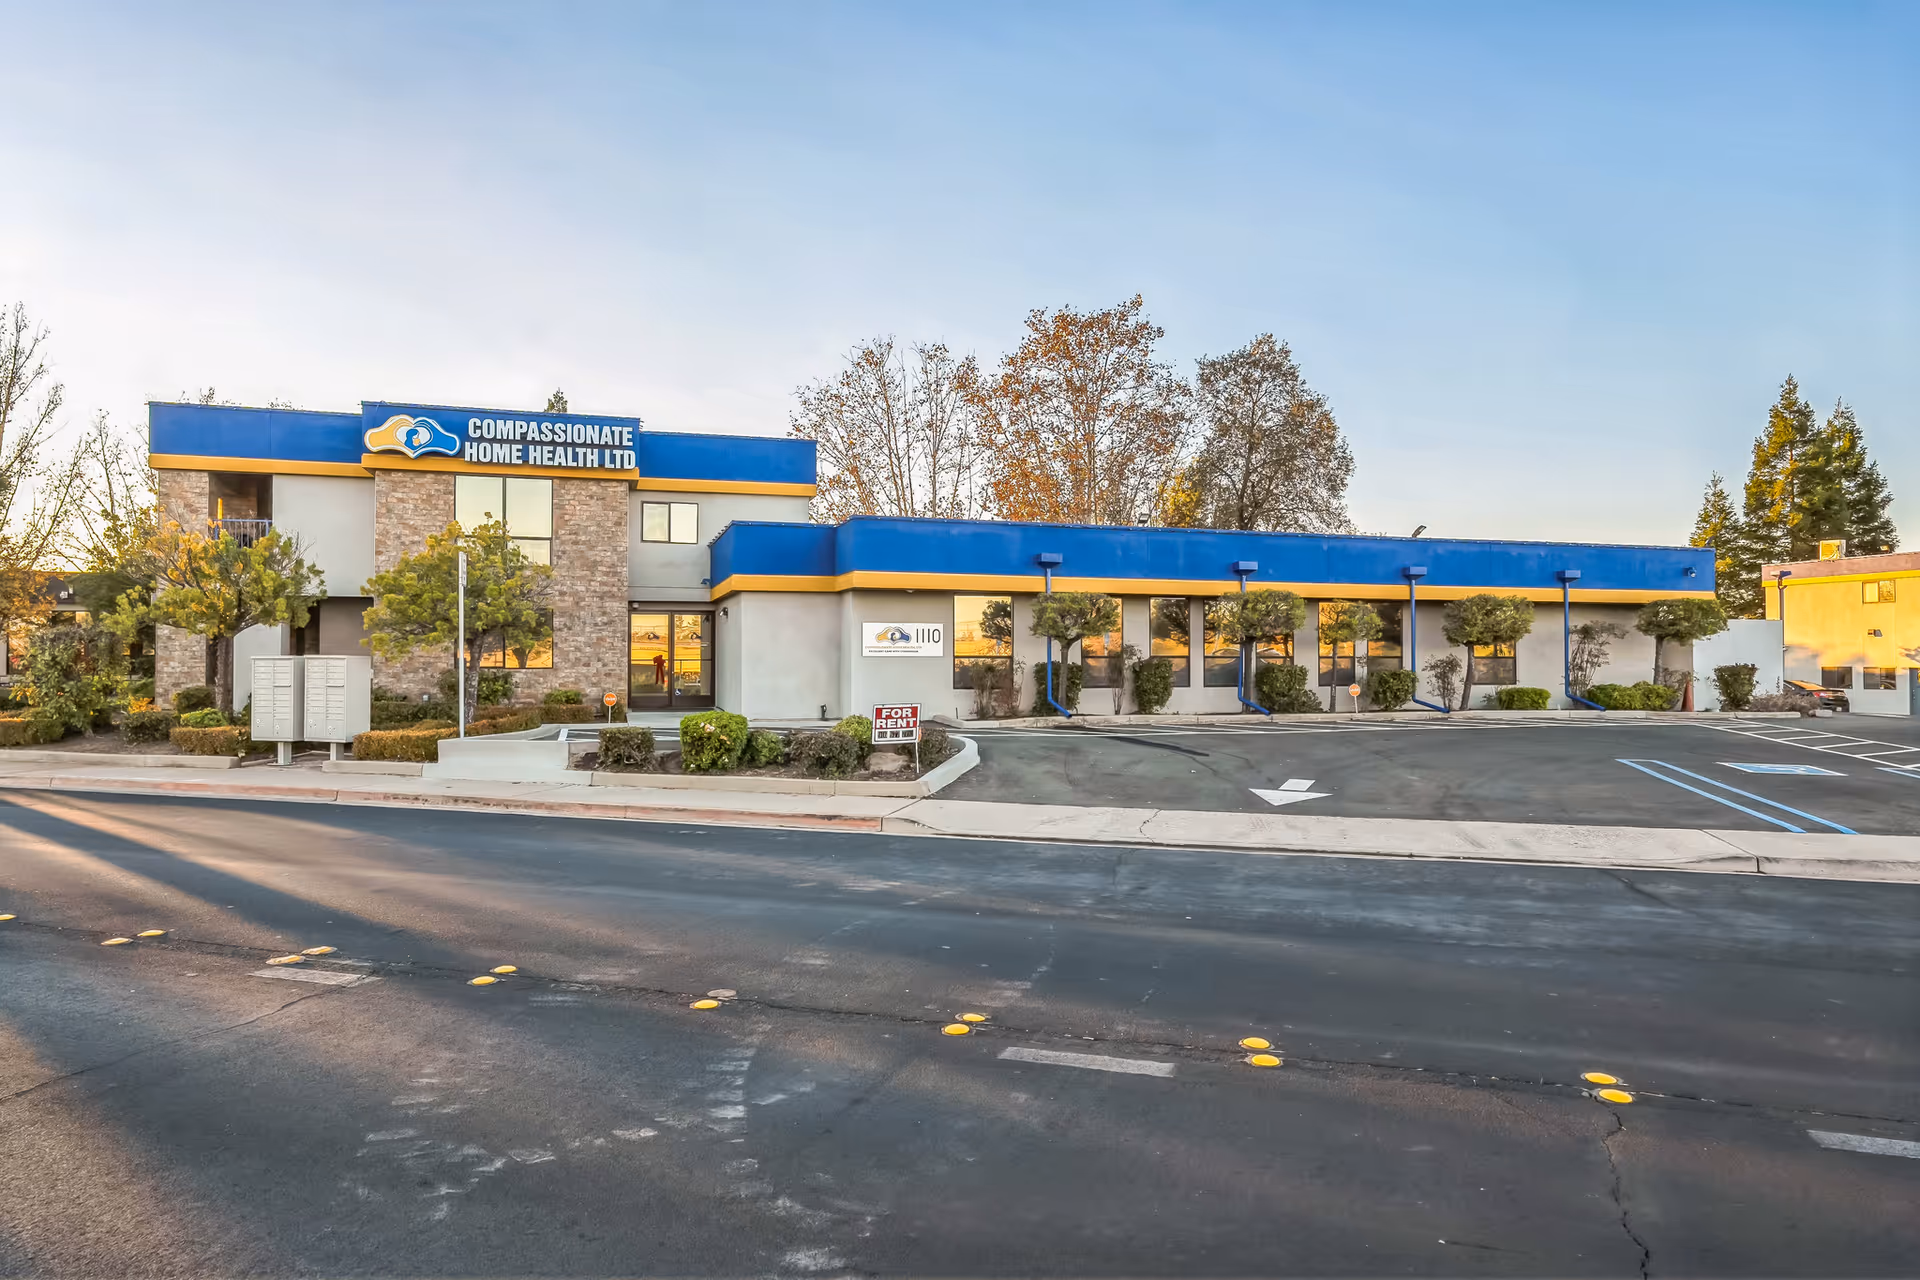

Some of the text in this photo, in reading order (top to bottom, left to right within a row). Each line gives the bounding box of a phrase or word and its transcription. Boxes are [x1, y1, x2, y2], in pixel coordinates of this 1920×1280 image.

[468, 417, 633, 446] COMPASSIONATE
[464, 442, 636, 469] HOME HEALTH LTD
[916, 628, 941, 644] 1110
[881, 708, 912, 718] FOR
[876, 718, 917, 728] RENT
